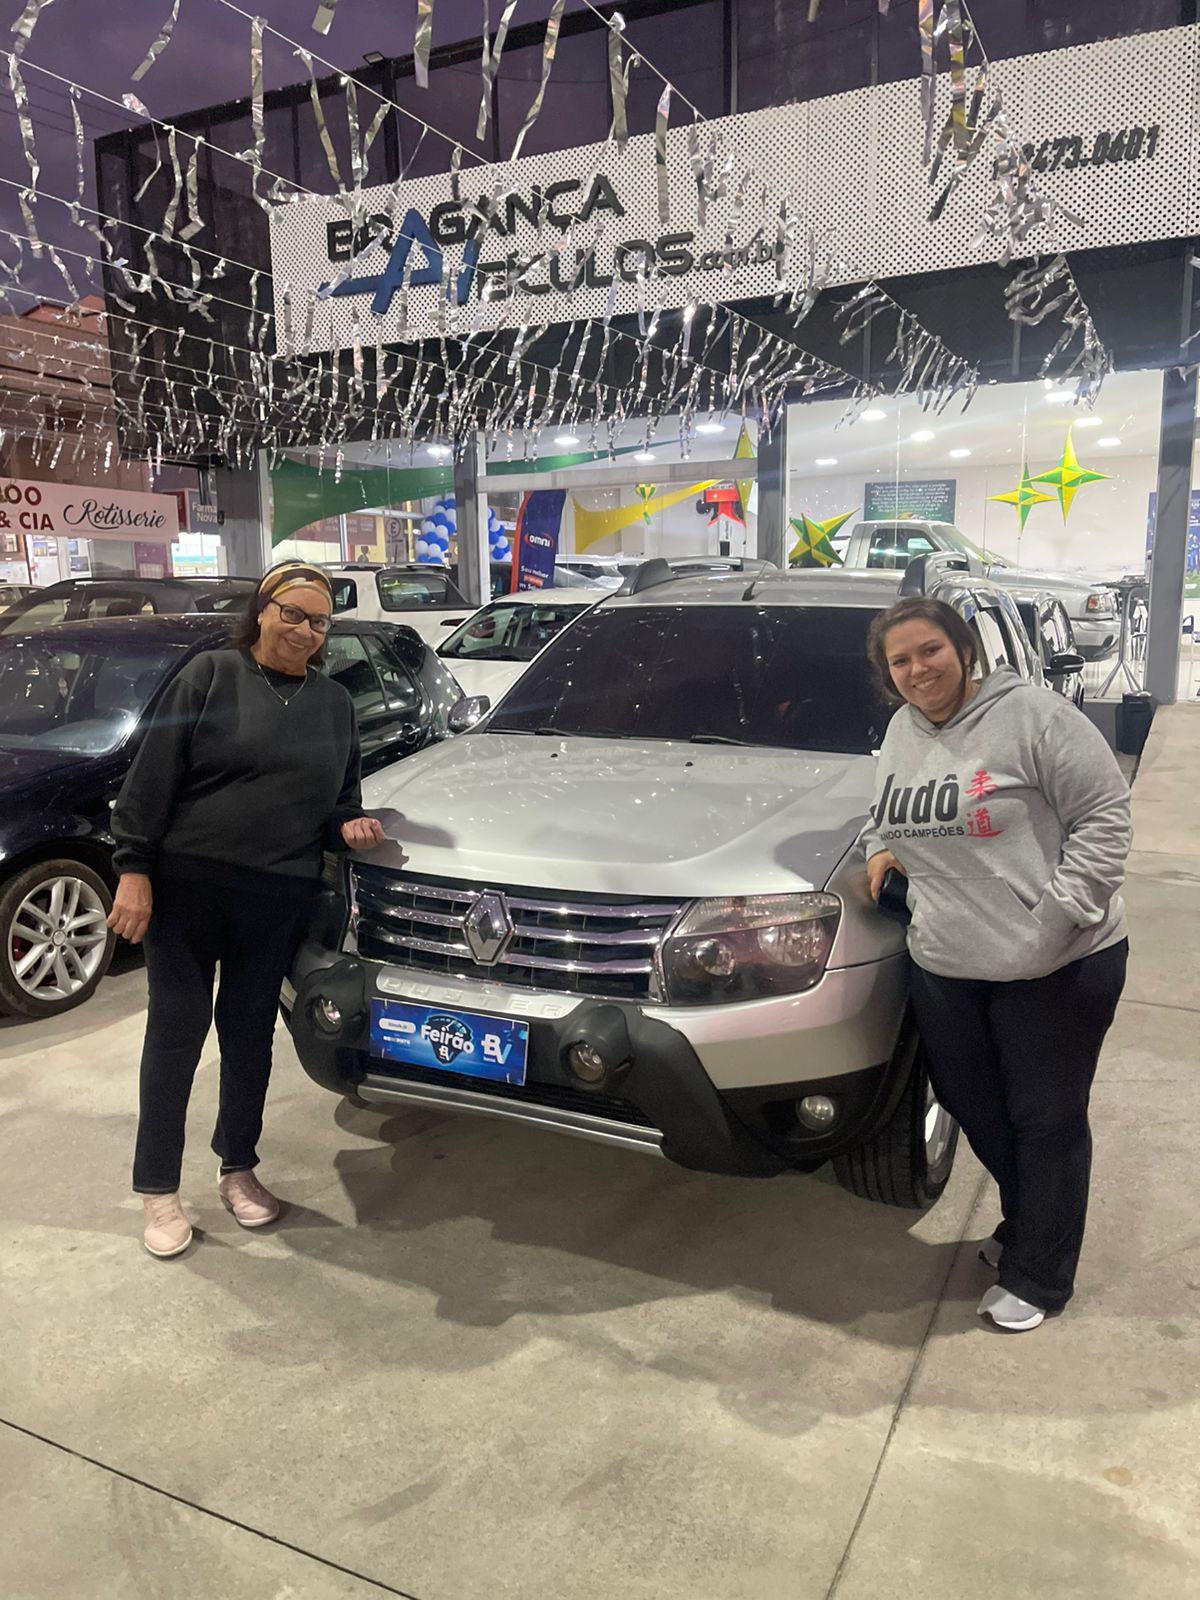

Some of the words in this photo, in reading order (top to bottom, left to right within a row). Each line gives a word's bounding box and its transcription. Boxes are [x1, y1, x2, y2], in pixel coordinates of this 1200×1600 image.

[0, 484, 42, 506] OO
[19, 511, 55, 531] CIA
[63, 499, 167, 530] Rotisserie
[196, 511, 217, 523] Nova
[529, 534, 551, 547] omni
[869, 773, 960, 829] Judô
[964, 769, 1006, 839] 柔道
[904, 825, 965, 838] CAMPEÕES
[421, 1024, 475, 1054] Feirão
